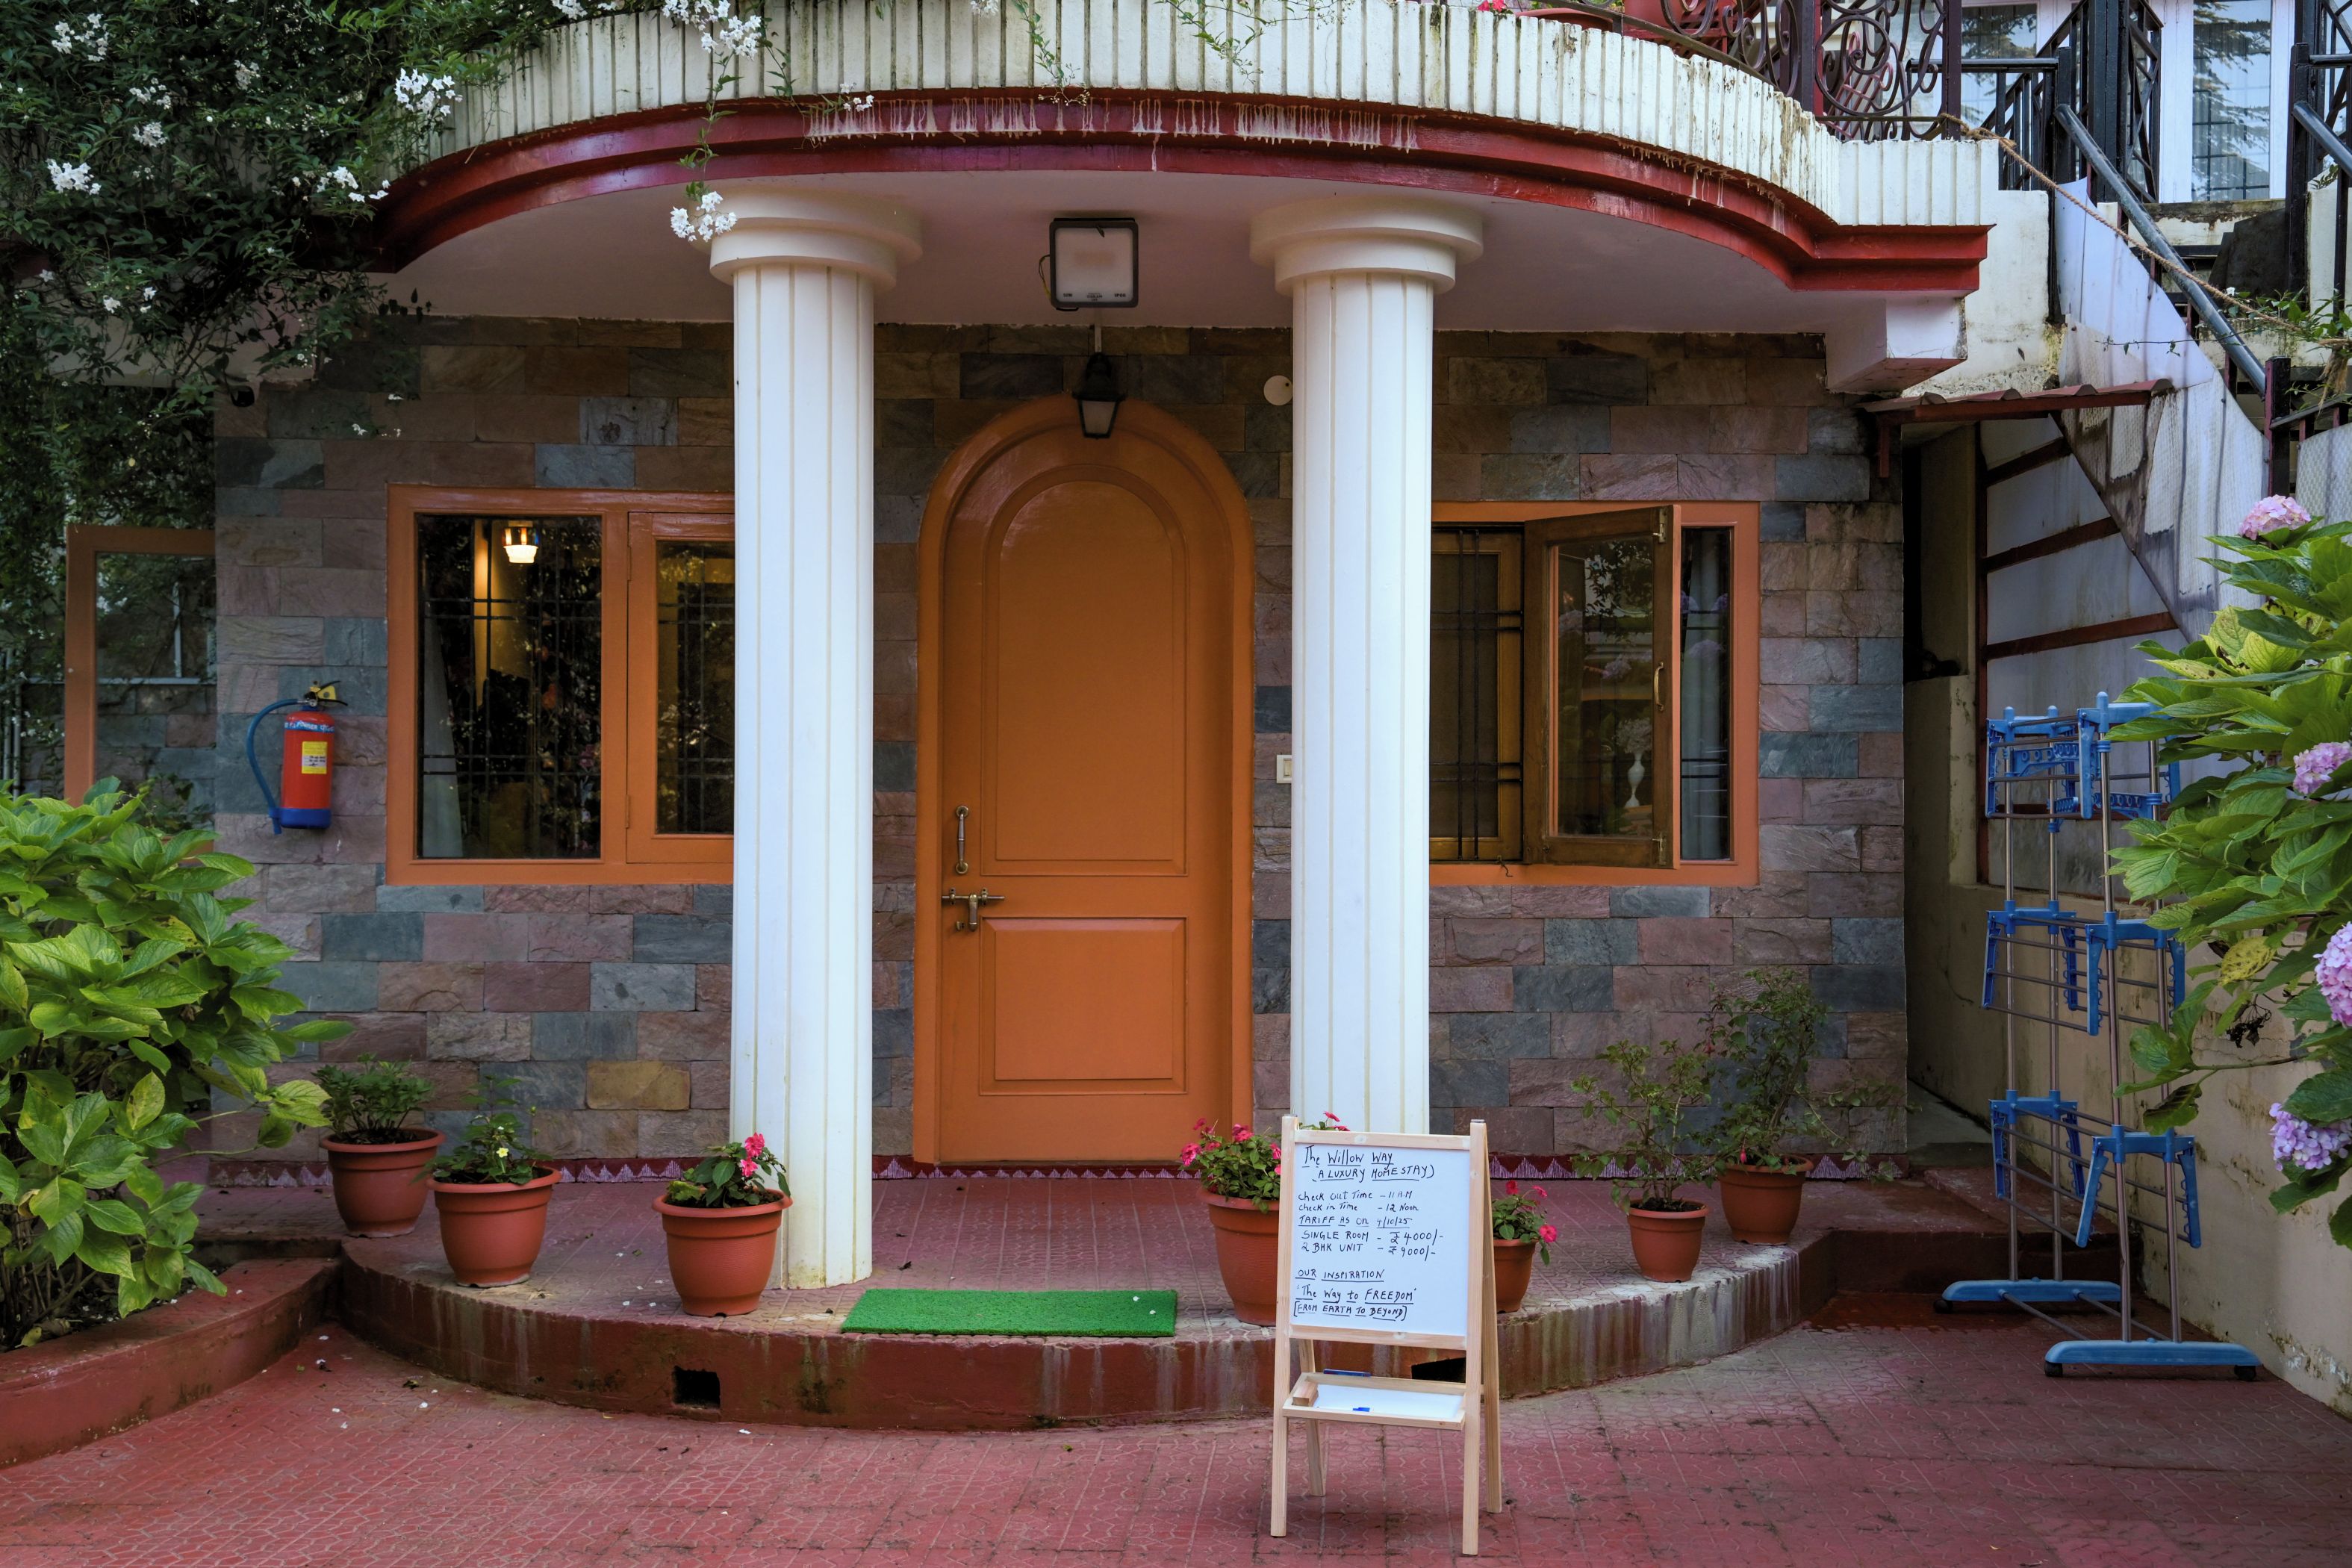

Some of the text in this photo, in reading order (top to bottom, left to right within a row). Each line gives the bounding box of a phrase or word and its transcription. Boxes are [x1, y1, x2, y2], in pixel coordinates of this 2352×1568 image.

[1305, 1145, 1320, 1165] The
[1328, 1169, 1365, 1183] LUXURY
[1352, 1189, 1373, 1200] Time
[1339, 1201, 1358, 1210] Time
[1399, 1202, 1419, 1212] Noon
[1298, 1214, 1335, 1225] TARIFF
[1340, 1216, 1350, 1225] AS
[1301, 1230, 1340, 1240] SINGLE
[1345, 1231, 1369, 1242] ROOM
[1301, 1242, 1309, 1251] 2
[1312, 1242, 1332, 1253] BHK
[1340, 1243, 1363, 1252] UNIT
[1298, 1269, 1385, 1280] OUR INSPIRATION
[1324, 1288, 1341, 1304] Way
[1347, 1289, 1359, 1300] to
[1322, 1304, 1352, 1314] EARTH
[1355, 1306, 1366, 1314] TO
[1369, 1305, 1407, 1322] BEYOND]
